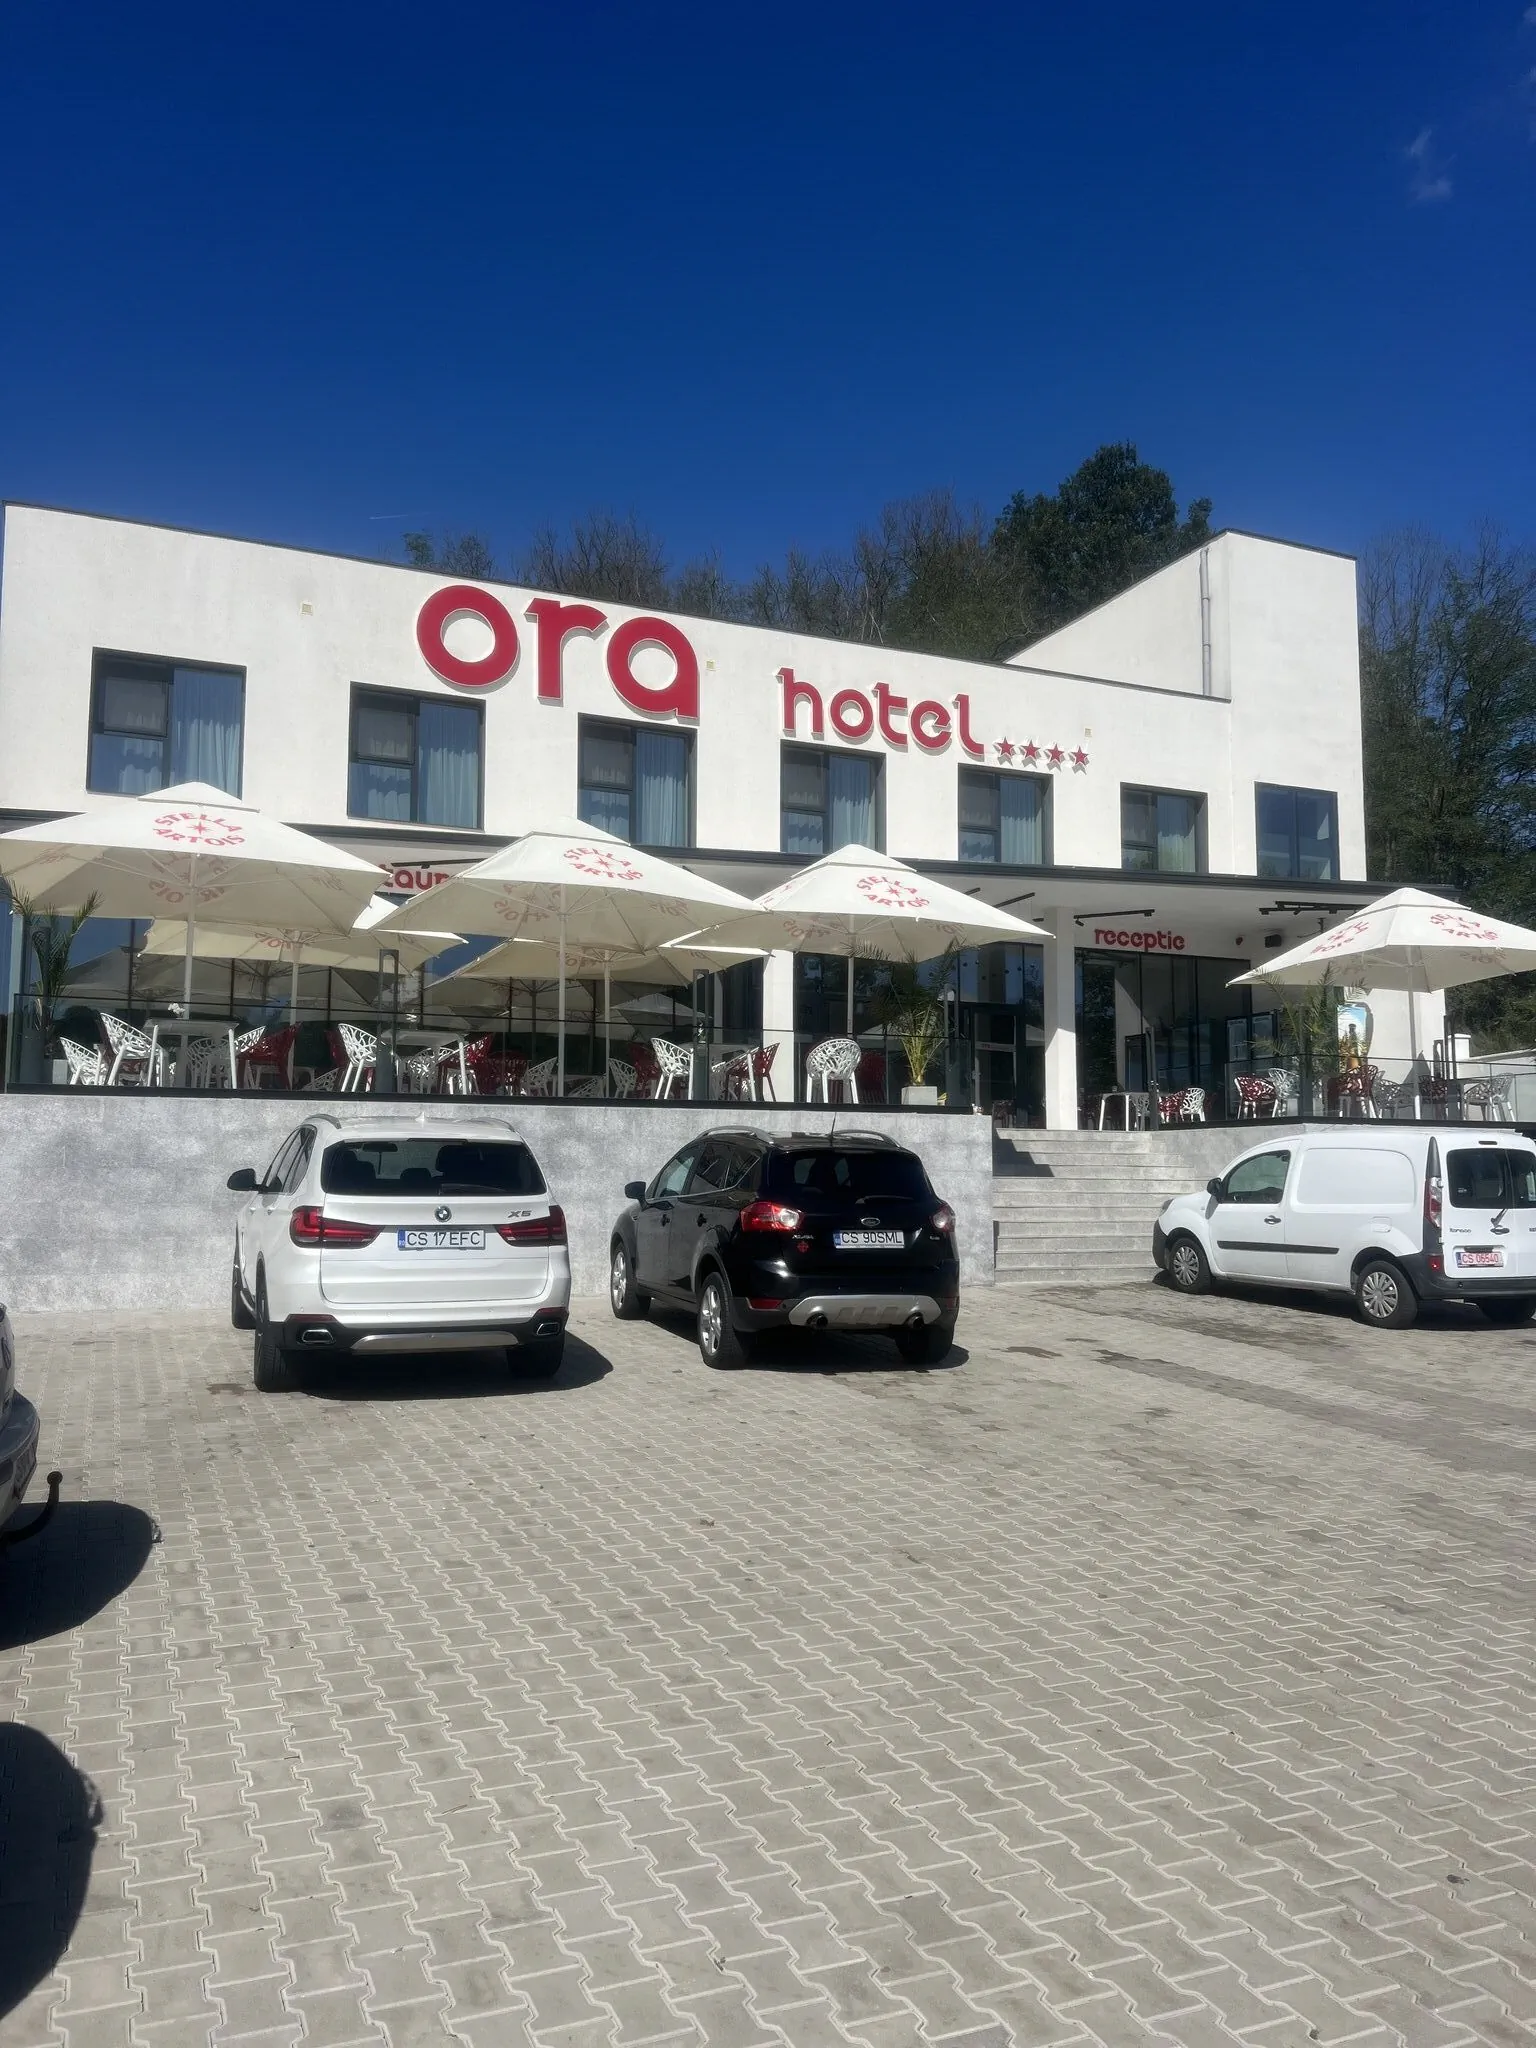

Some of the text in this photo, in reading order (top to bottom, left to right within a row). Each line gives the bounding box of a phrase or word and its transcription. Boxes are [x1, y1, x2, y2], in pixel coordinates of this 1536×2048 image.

[416, 584, 985, 756] ora hotel
[154, 812, 243, 832] STELLA
[152, 828, 246, 846] ARTOIS
[1094, 928, 1186, 953] receptie
[507, 1210, 532, 1218] X5
[407, 1232, 428, 1246] CS
[841, 1231, 859, 1244] CS
[1461, 1253, 1475, 1264] CS
